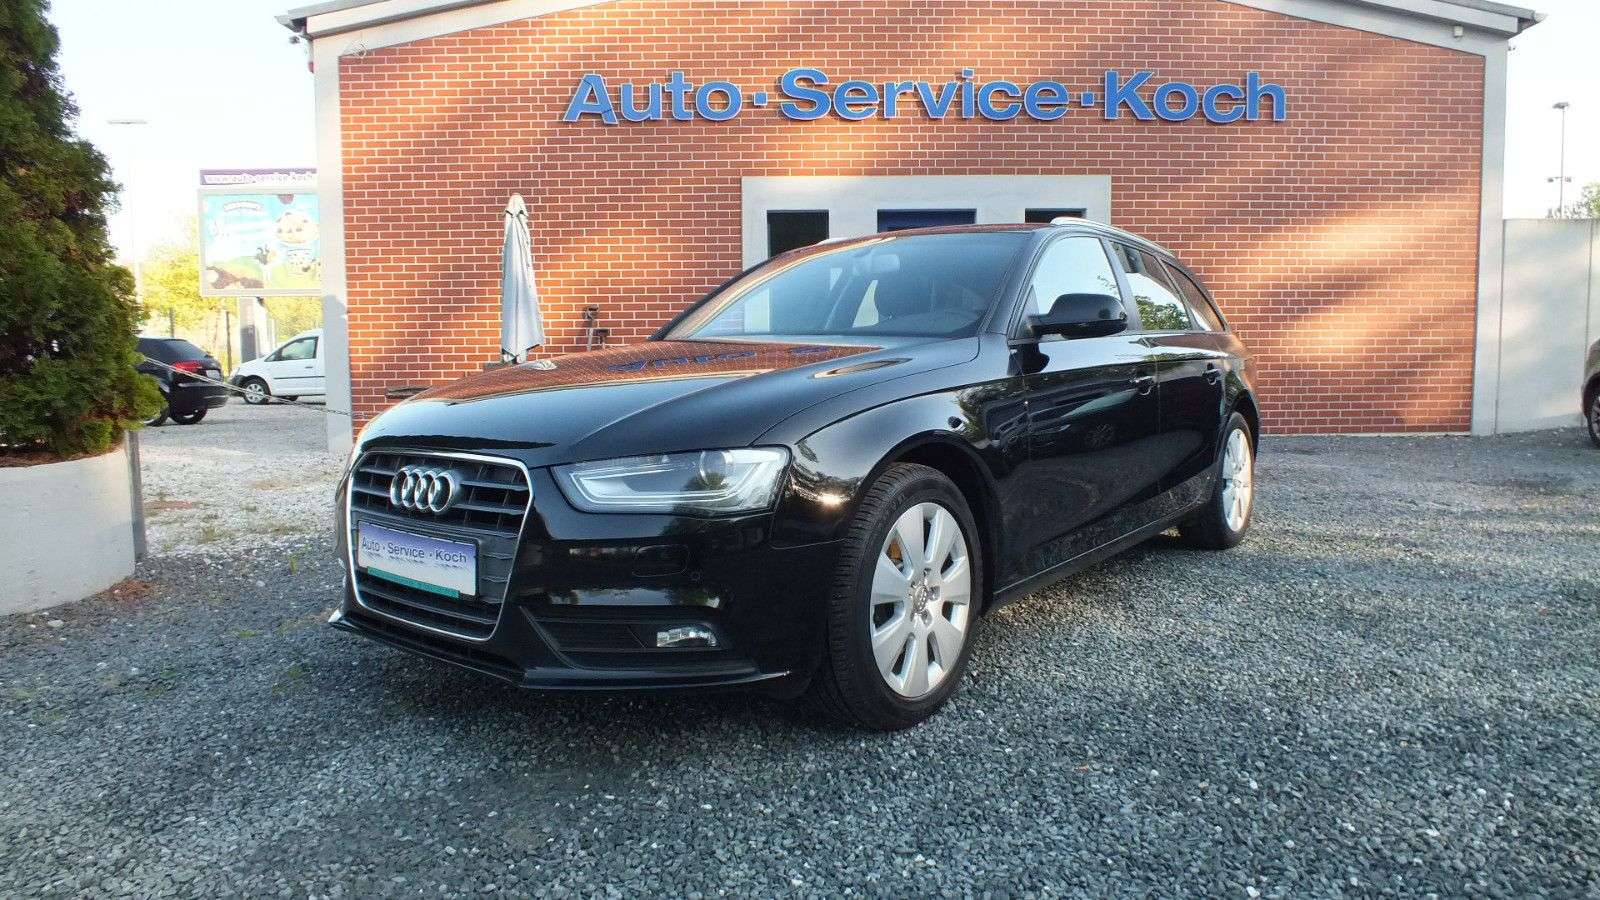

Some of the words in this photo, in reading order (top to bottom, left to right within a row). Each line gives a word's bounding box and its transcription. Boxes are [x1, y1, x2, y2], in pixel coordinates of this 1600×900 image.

[563, 71, 742, 125] Auto
[780, 67, 1070, 122] Service
[1104, 69, 1286, 124] Koch
[387, 541, 425, 559] Service
[435, 549, 467, 563] Koch
